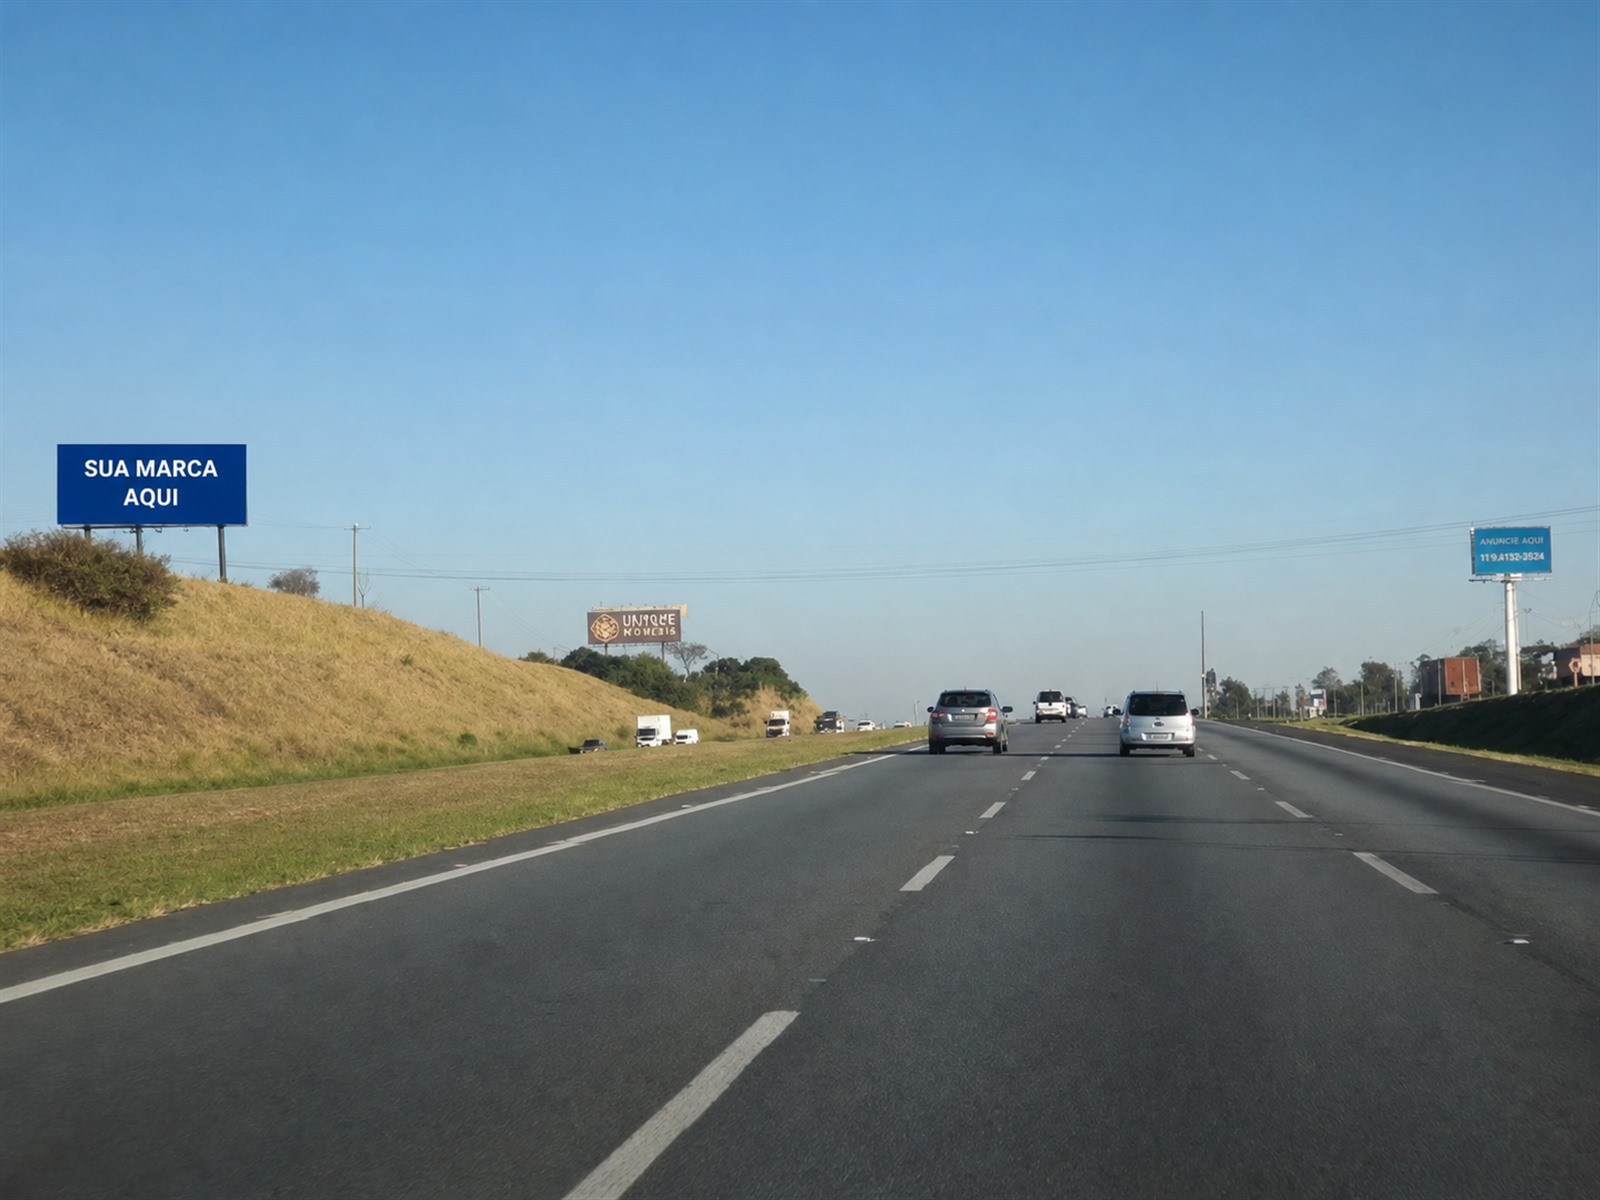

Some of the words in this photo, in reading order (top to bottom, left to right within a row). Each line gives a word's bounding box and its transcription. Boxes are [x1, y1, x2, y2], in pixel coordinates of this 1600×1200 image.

[84, 459, 130, 477] SUA
[136, 459, 218, 477] MARCA
[123, 488, 178, 508] AQUI
[1480, 537, 1519, 545] ANUNCIE
[1522, 536, 1544, 544] AQUI
